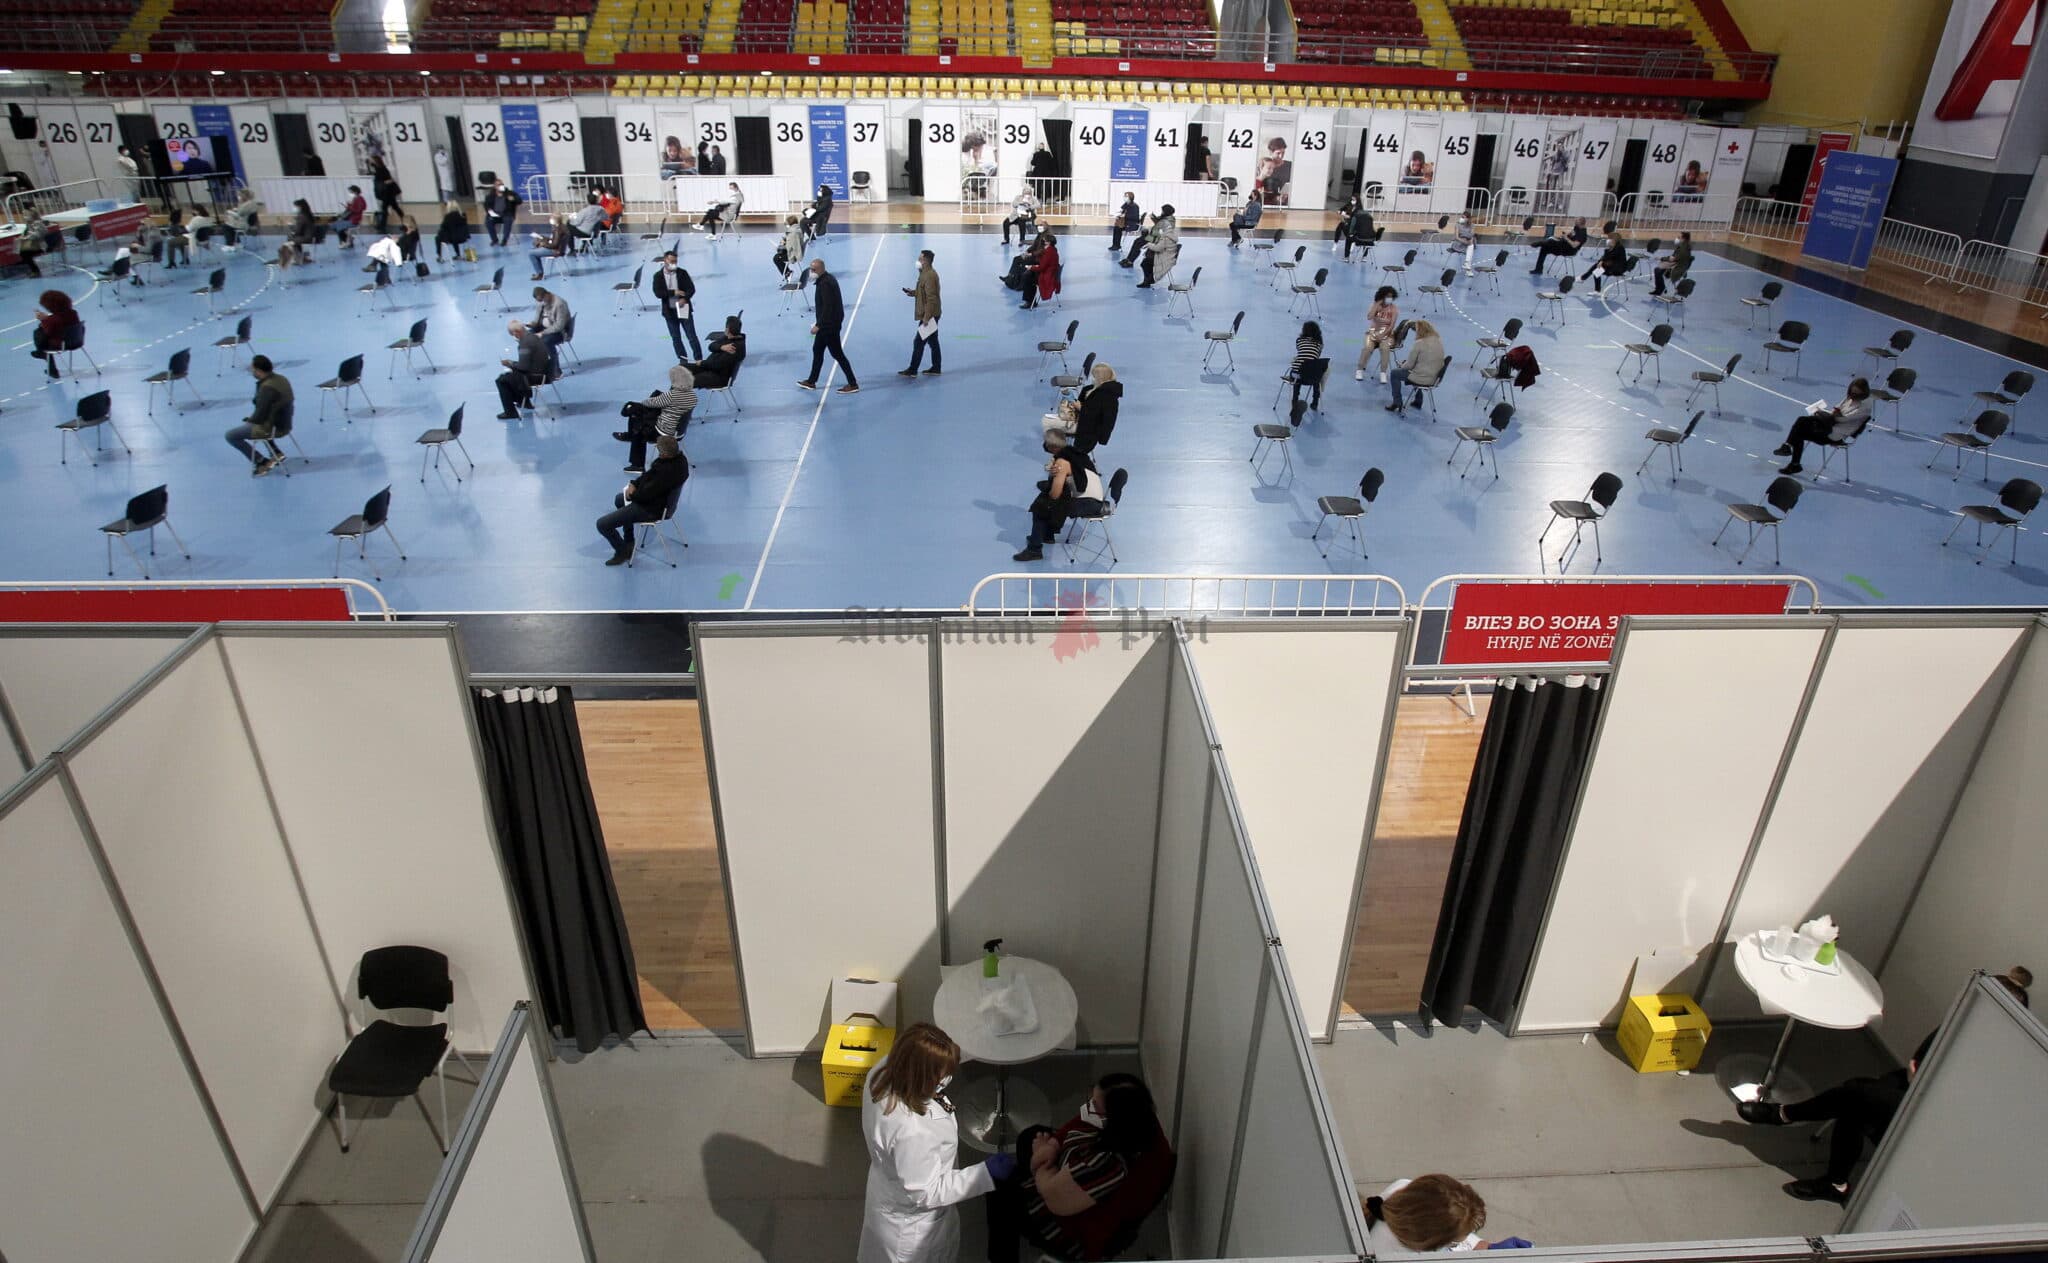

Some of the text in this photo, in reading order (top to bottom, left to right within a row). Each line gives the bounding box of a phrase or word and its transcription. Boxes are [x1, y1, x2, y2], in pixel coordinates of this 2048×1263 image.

[47, 122, 78, 144] 26
[86, 122, 113, 143] 27
[162, 122, 193, 140] 28
[239, 121, 269, 143] 29
[317, 122, 346, 143] 30
[394, 121, 423, 143] 31
[471, 121, 499, 143] 32
[547, 121, 576, 143] 33
[624, 121, 652, 142] 34
[700, 121, 729, 143] 35
[776, 122, 804, 143] 36
[853, 122, 879, 143] 37
[928, 123, 955, 144] 38
[1004, 124, 1030, 145] 39
[1079, 125, 1106, 146] 40
[1154, 127, 1179, 148] 41
[1227, 128, 1254, 149] 42
[1300, 130, 1327, 151] 43
[1372, 133, 1399, 153] 44
[1444, 135, 1470, 156] 45
[1513, 138, 1540, 159] 46
[1583, 140, 1610, 161] 47
[1651, 143, 1677, 164] 48
[1464, 615, 1513, 630] ВЛЕЗ
[1516, 615, 1545, 630] ВО
[1549, 615, 1602, 630] ЗОНА
[1486, 635, 1535, 651] HYRJE
[1538, 633, 1561, 649] NË
